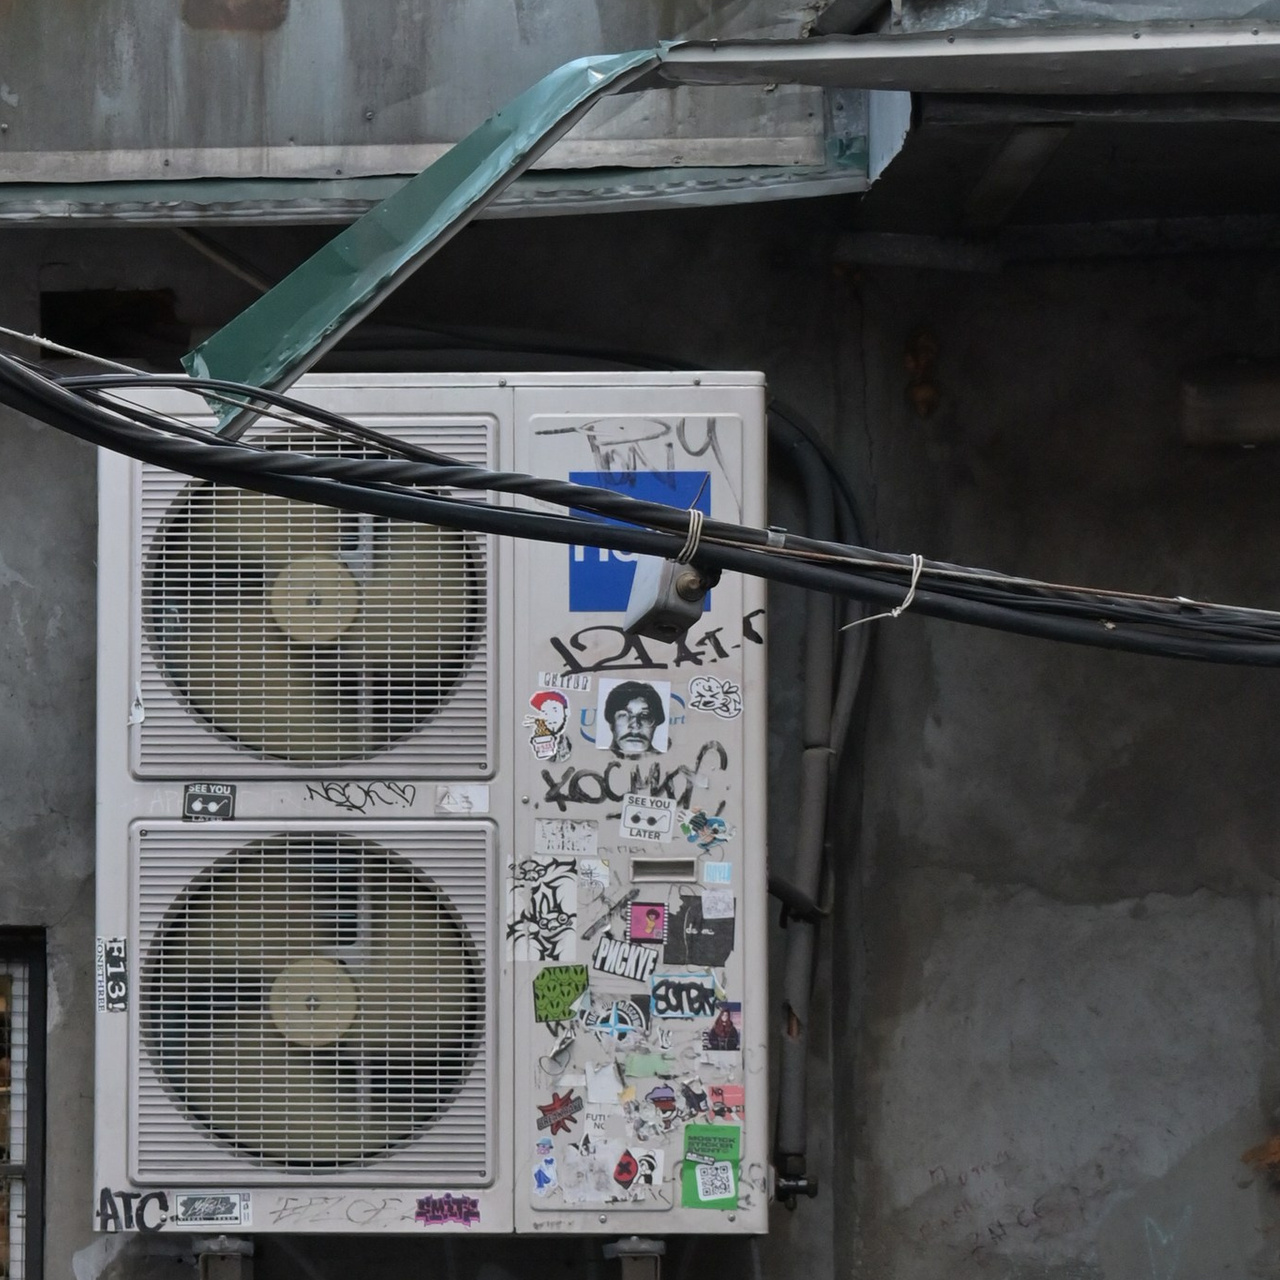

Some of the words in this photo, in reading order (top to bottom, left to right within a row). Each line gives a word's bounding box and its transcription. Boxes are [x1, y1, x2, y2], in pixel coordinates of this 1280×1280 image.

[188, 784, 208, 793] SEE
[209, 785, 231, 794] YOU
[627, 795, 647, 807] SEE
[649, 798, 671, 809] YOU
[629, 829, 661, 840] LATER
[688, 1141, 733, 1149] STICKER
